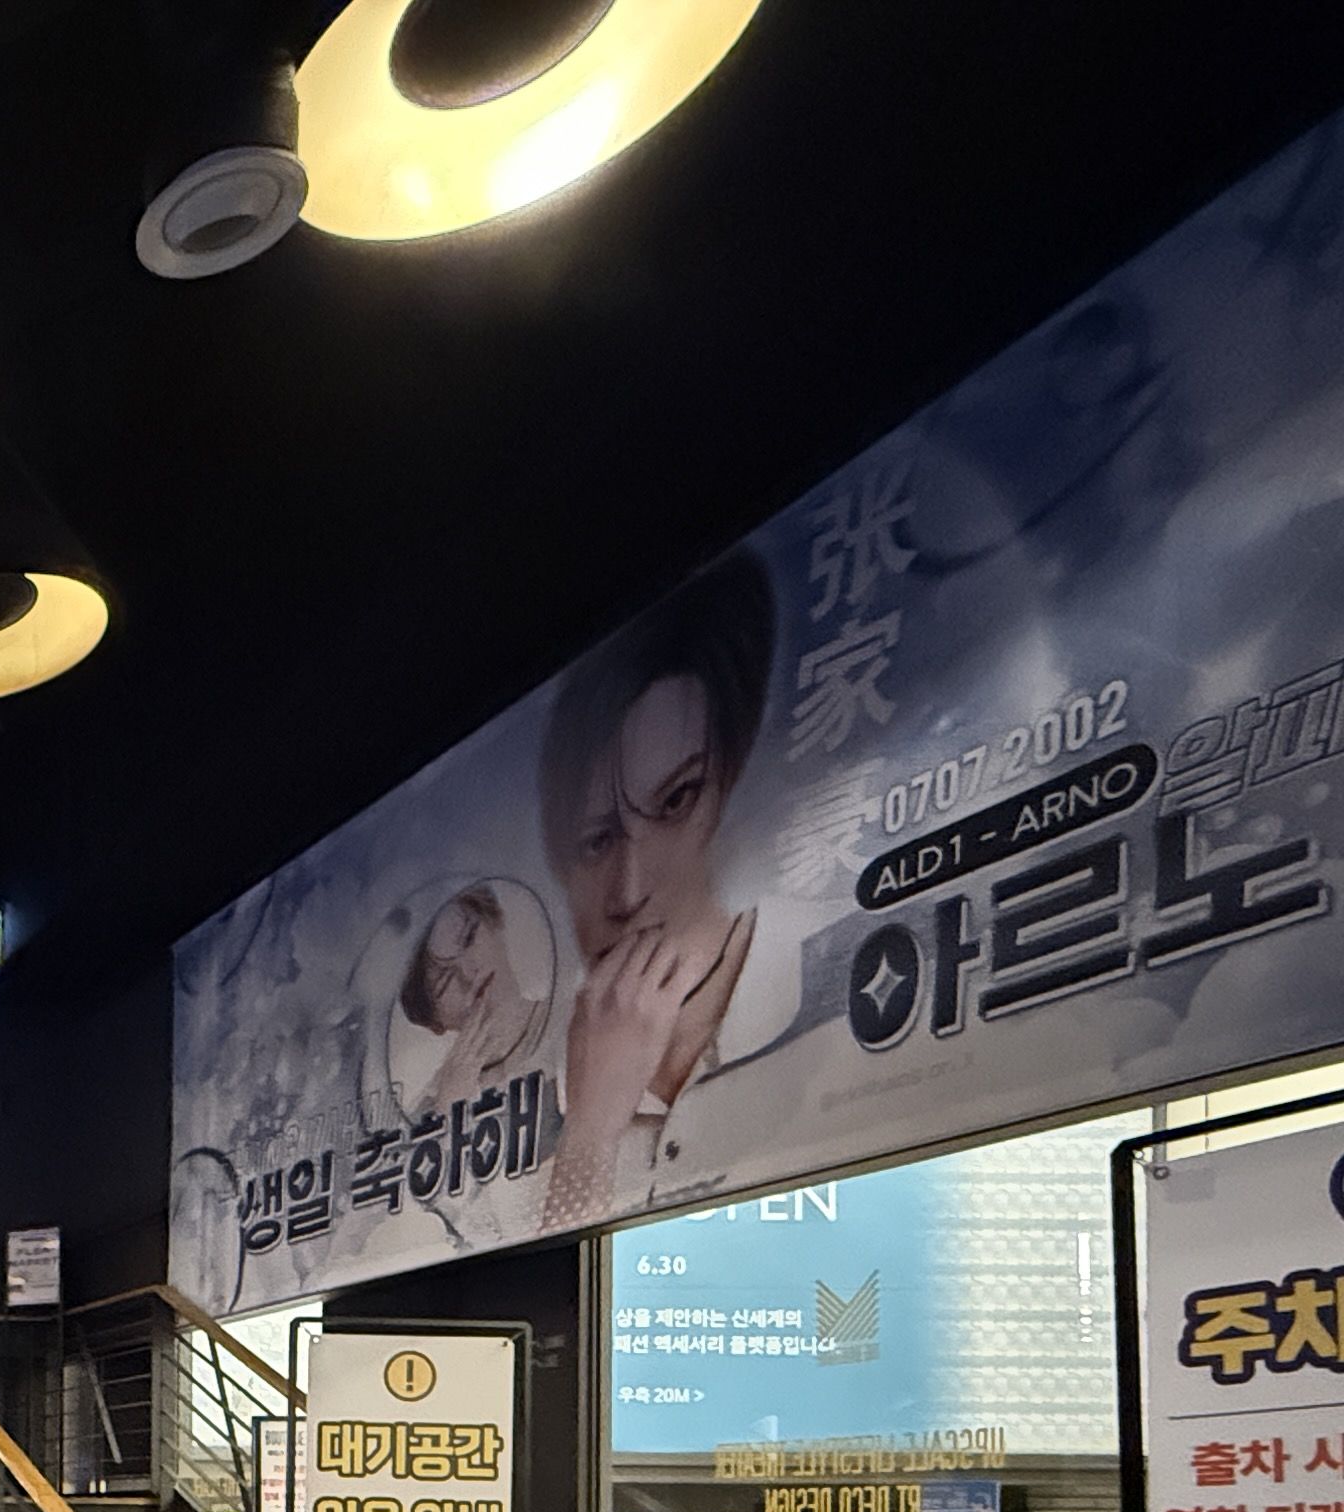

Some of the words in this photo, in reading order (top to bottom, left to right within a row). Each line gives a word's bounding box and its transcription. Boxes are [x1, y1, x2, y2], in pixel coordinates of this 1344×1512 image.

[882, 677, 1130, 836] 0707.2002
[872, 832, 964, 899] ALD1
[1012, 763, 1138, 842] ARNO
[846, 808, 1333, 1052] 아르노
[238, 1148, 338, 1255] 생일
[350, 1068, 546, 1214] 축하해
[637, 1256, 686, 1275] 6.30
[655, 1308, 726, 1328] 제안하는
[732, 1309, 802, 1328] 신세계의
[1178, 1265, 1344, 1385] 주차
[653, 1388, 690, 1403] 20M
[317, 1421, 503, 1481] 대기공간
[1191, 1438, 1291, 1486] 출차
